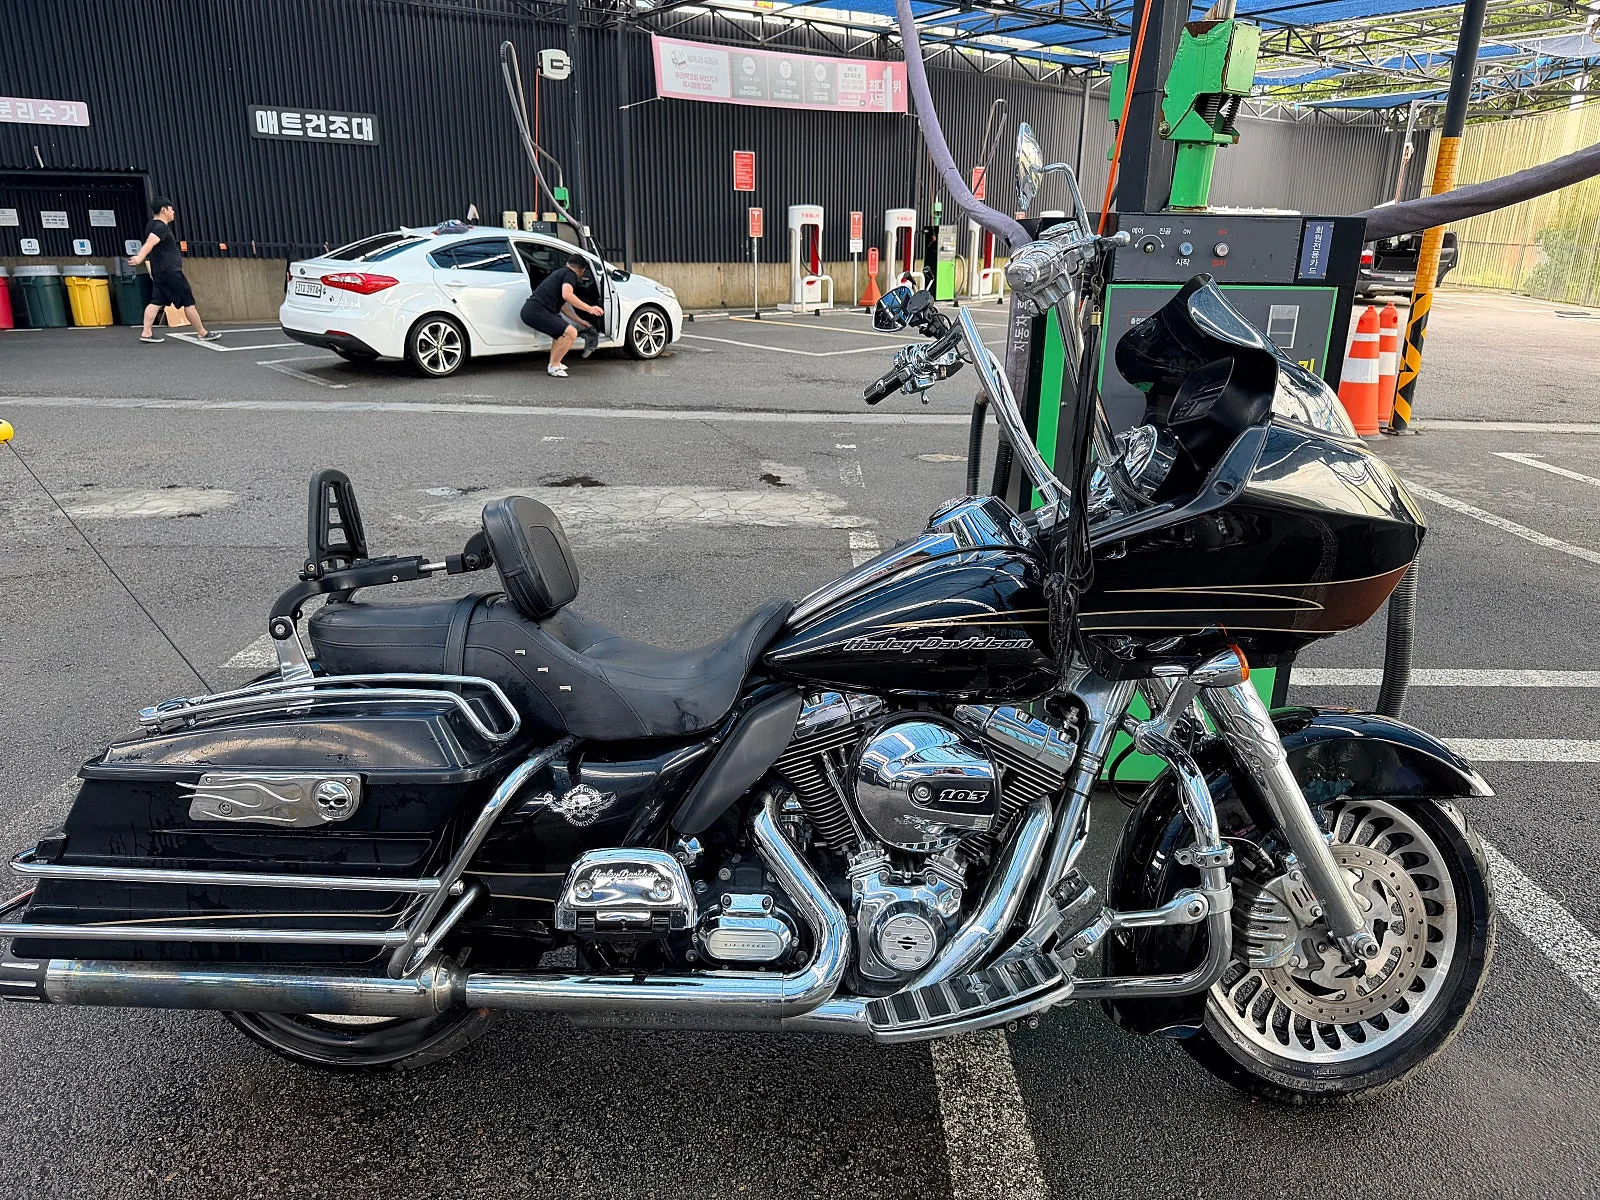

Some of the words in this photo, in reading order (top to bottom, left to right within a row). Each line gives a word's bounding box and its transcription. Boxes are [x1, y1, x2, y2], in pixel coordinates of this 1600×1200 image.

[255, 110, 374, 141] 매트건조대
[1131, 227, 1144, 235] 에어
[1159, 227, 1172, 236] 진공
[1308, 225, 1324, 275] 회원전용카드
[1175, 258, 1190, 267] 시작
[1013, 314, 1031, 352] 자동차
[843, 636, 1034, 654] Harley-Davidson
[938, 788, 990, 804] 103
